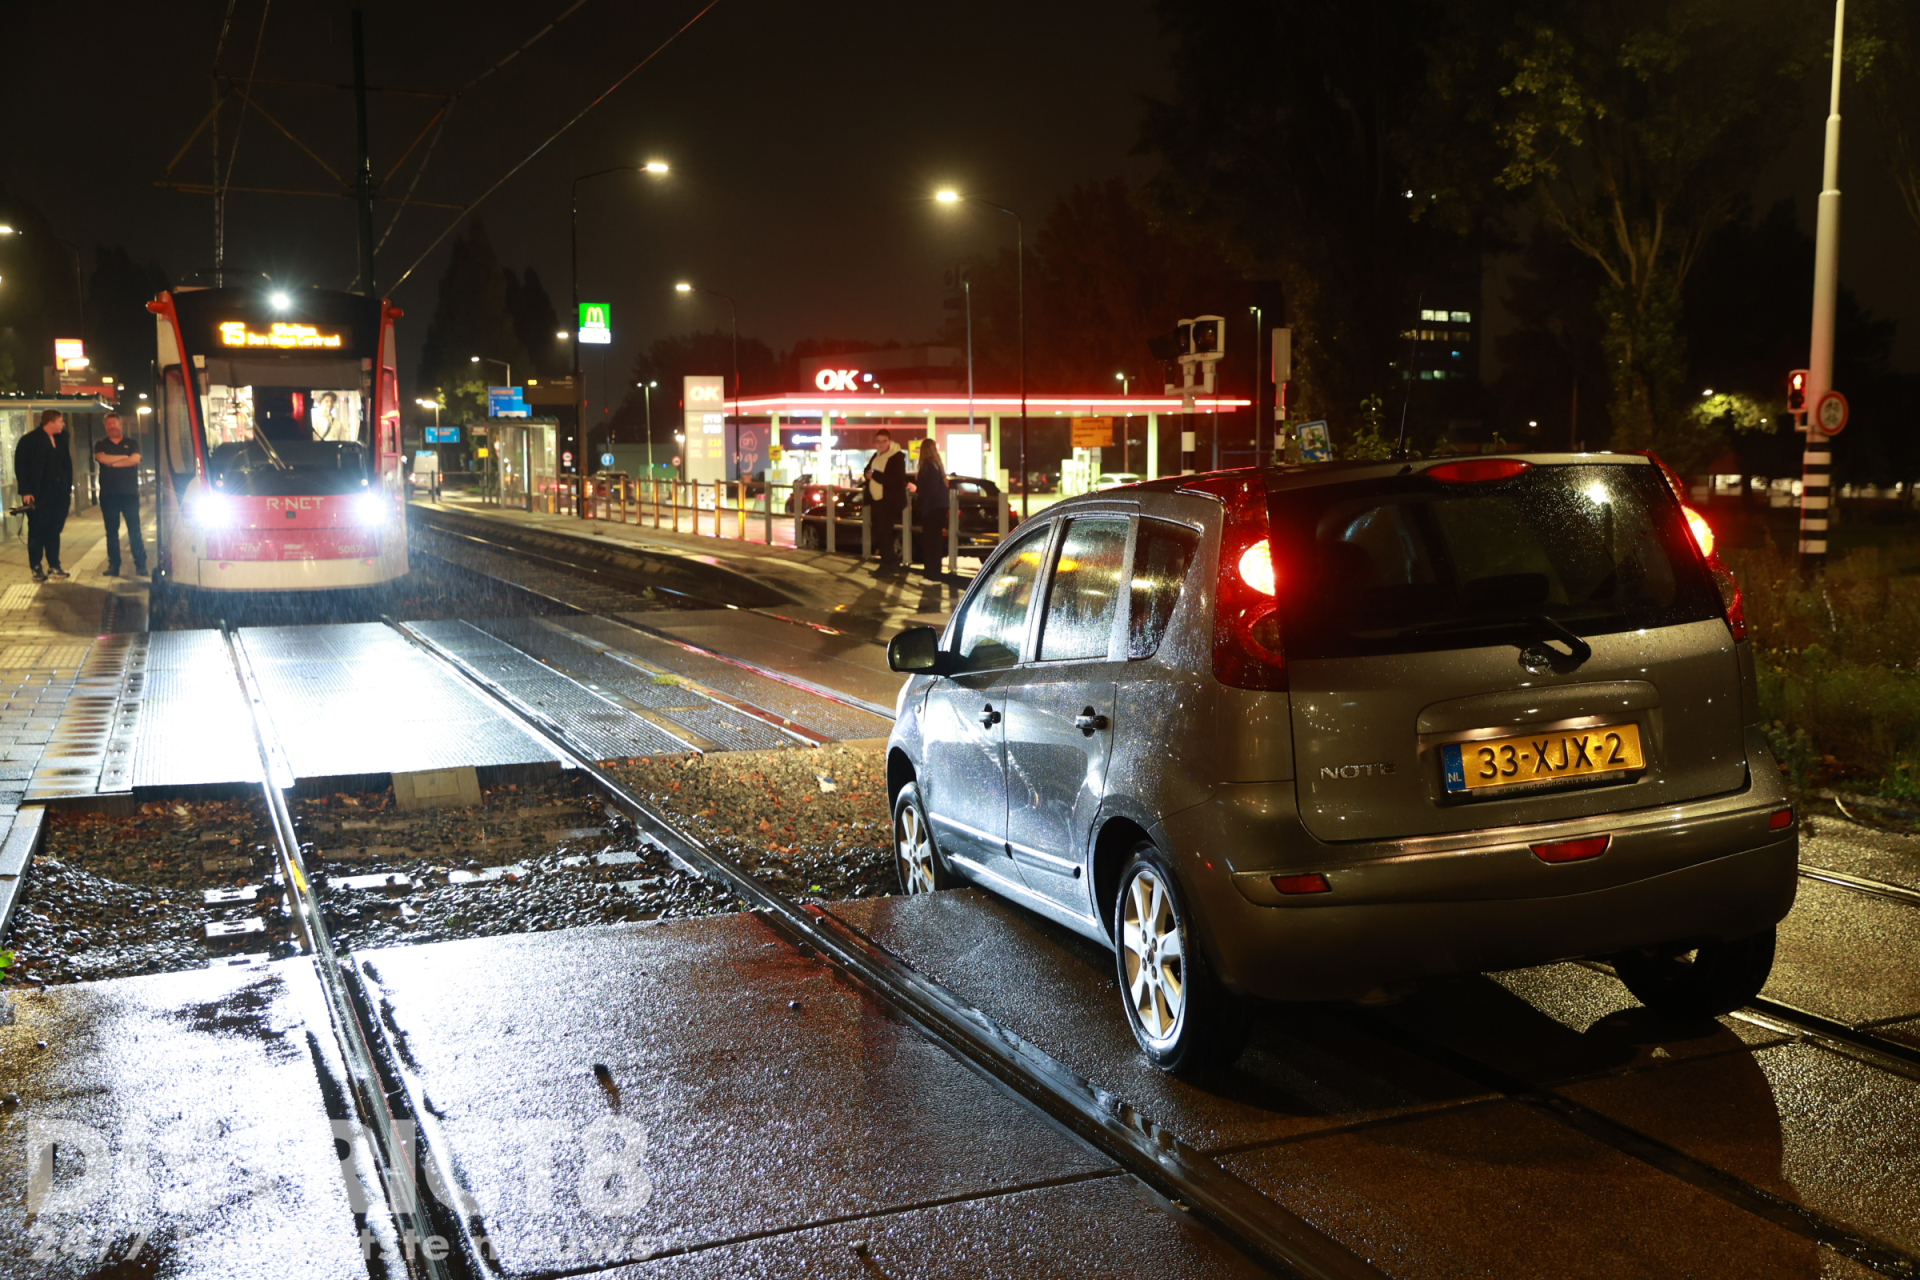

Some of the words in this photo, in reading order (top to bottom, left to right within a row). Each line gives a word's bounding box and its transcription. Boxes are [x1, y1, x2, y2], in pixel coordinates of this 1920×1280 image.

[219, 321, 246, 345] 15
[815, 369, 859, 391] OK
[689, 386, 720, 401] OK
[743, 453, 759, 473] go
[1478, 732, 1624, 779] 33-XJX-2
[1319, 761, 1397, 780] NOTE
[1448, 772, 1463, 783] NL
